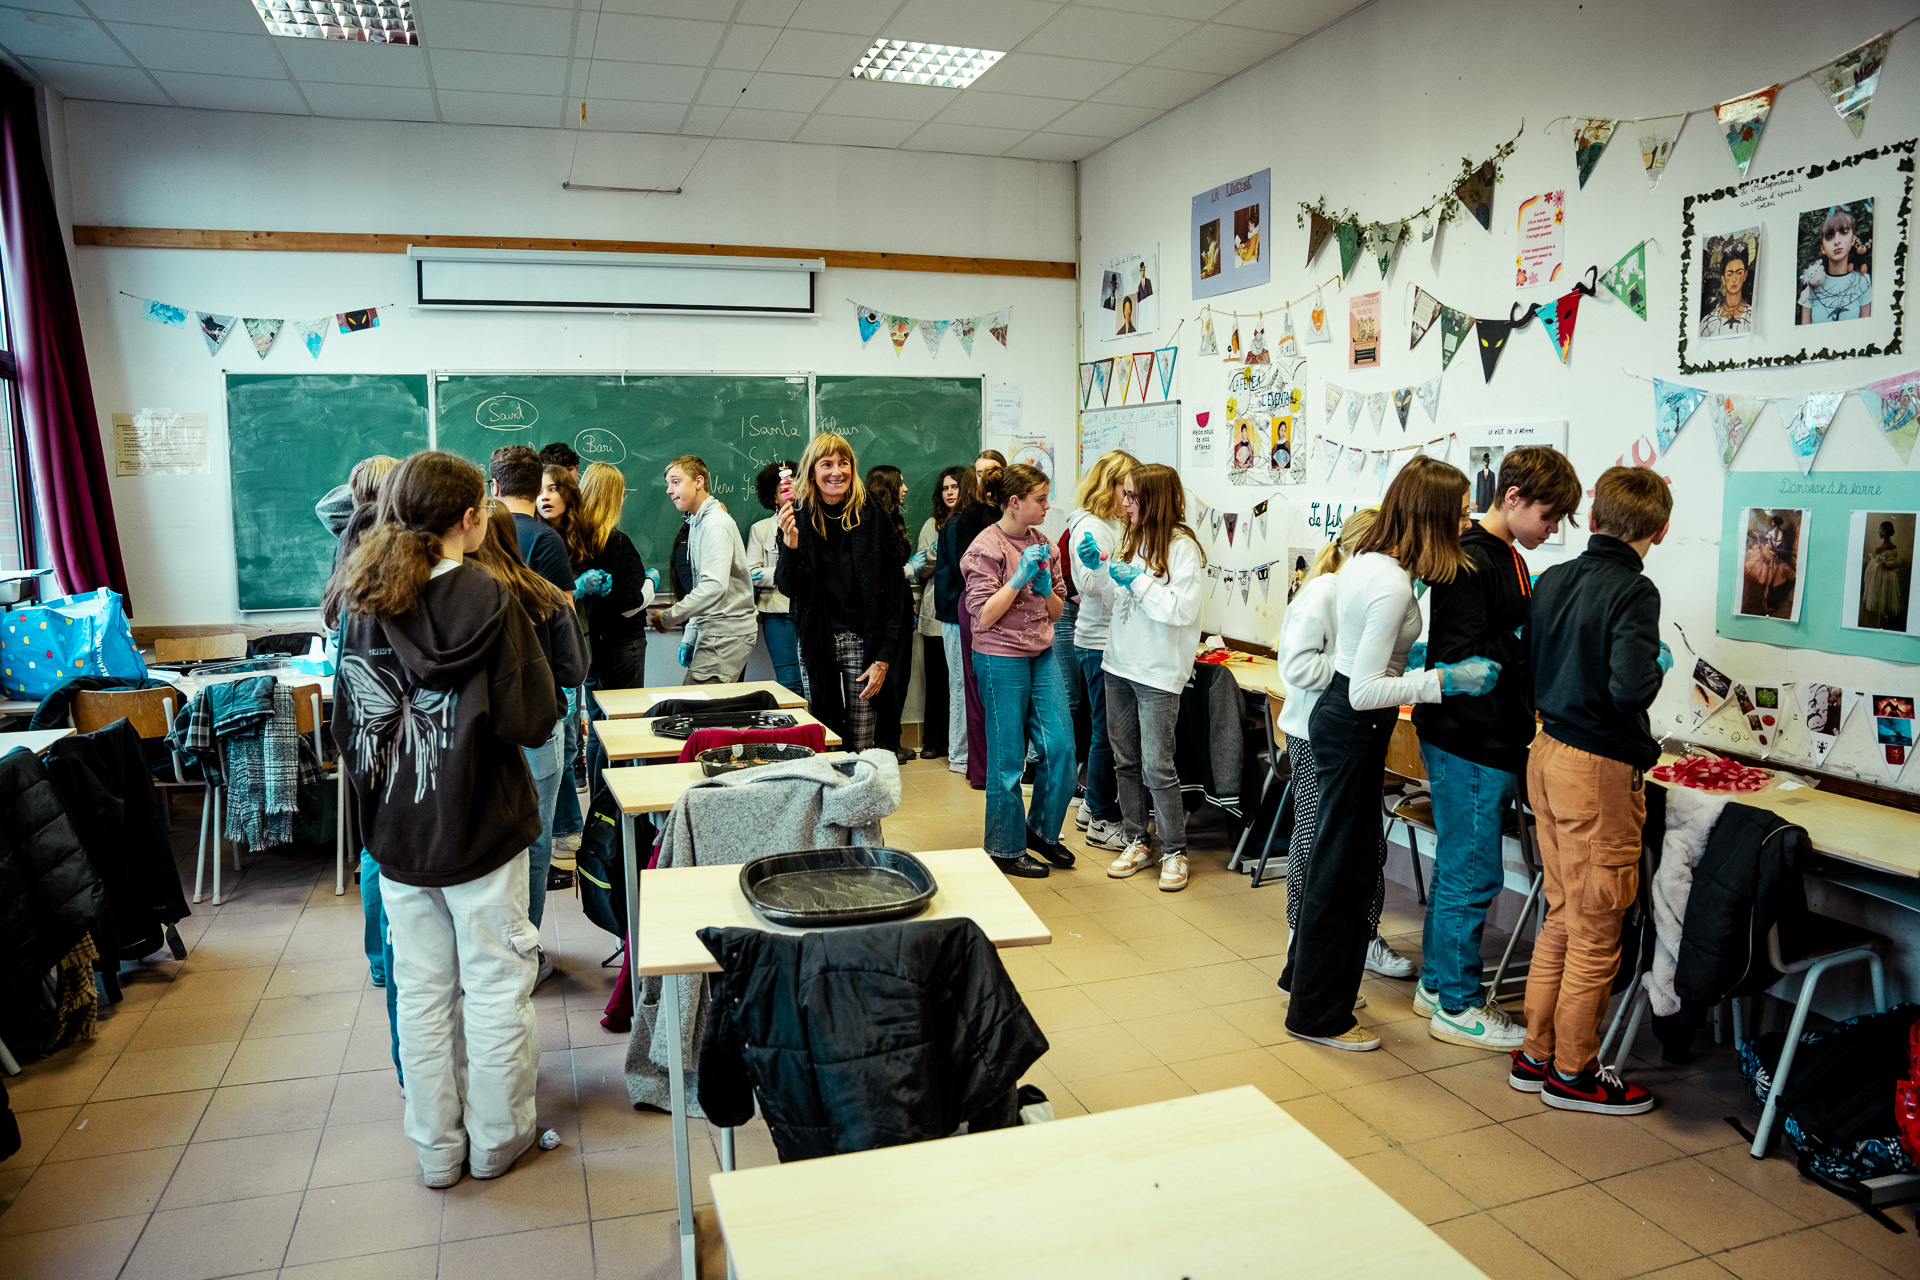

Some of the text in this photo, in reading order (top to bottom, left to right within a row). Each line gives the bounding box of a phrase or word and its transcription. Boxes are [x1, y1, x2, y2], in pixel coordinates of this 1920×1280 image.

[488, 403, 524, 422] Saint
[750, 415, 800, 438] Santa
[582, 434, 614, 454] Bari
